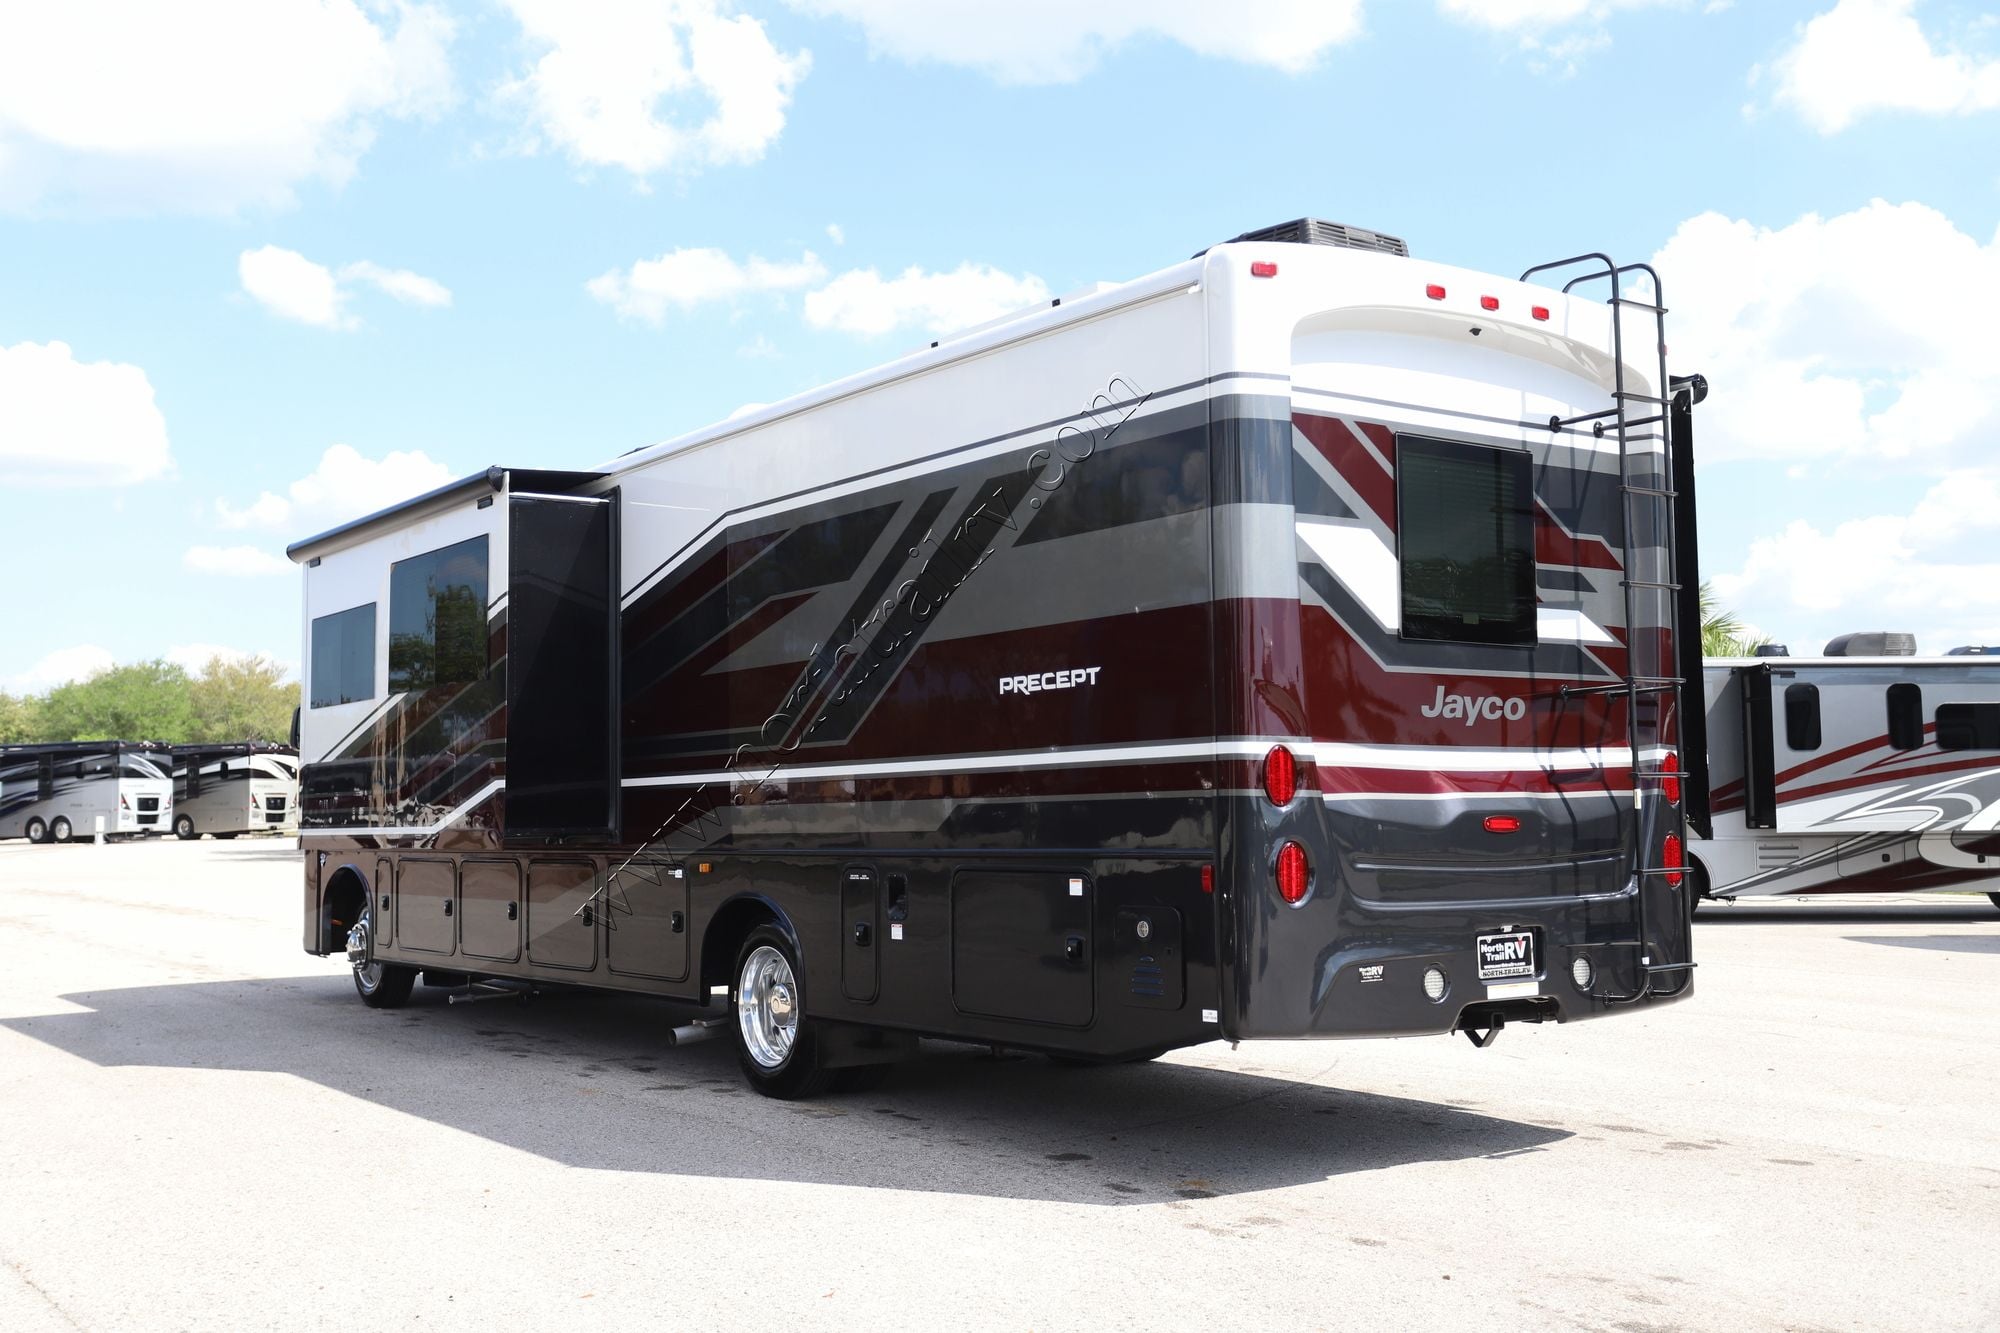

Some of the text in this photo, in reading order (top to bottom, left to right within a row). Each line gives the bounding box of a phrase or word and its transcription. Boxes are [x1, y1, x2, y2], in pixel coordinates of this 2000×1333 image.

[999, 666, 1101, 695] PRECEPT
[1421, 685, 1526, 726] Jayco
[1480, 943, 1504, 953] North
[1485, 952, 1504, 961] Trail
[1504, 940, 1526, 960] RV
